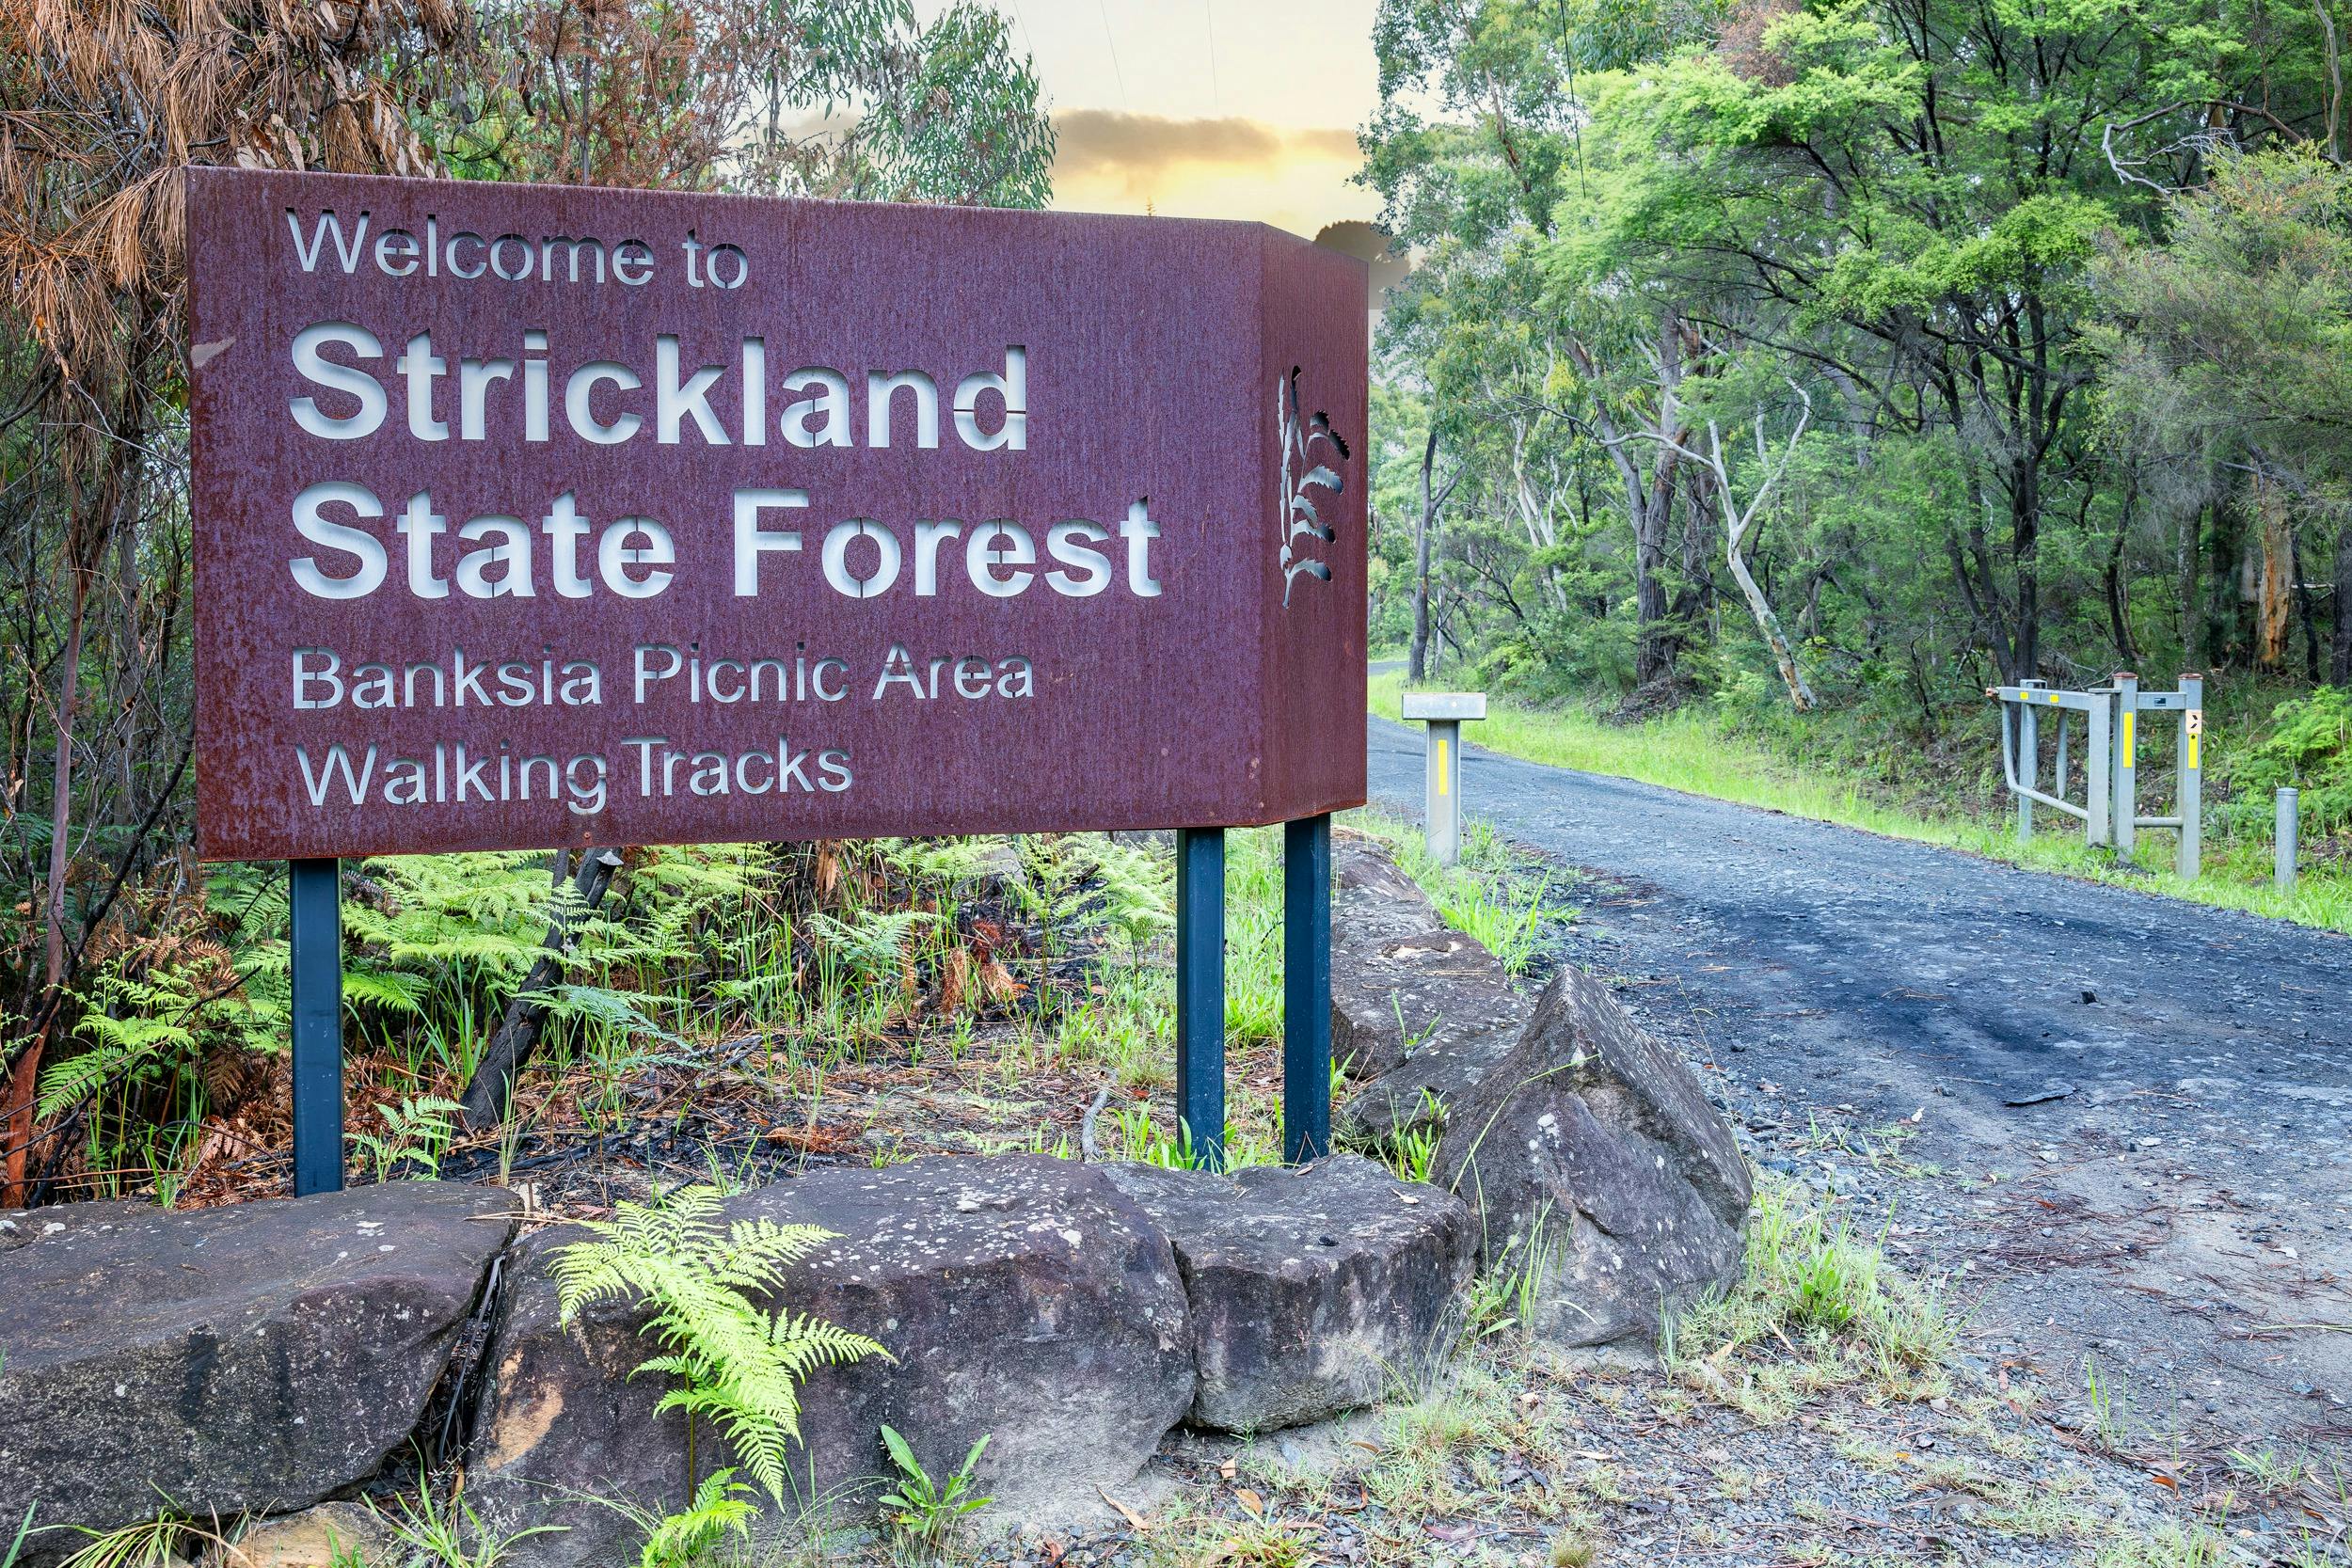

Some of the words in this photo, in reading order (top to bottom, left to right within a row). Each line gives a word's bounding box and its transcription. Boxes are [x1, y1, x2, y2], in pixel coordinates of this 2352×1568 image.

[285, 207, 655, 286] Welcome
[681, 229, 748, 290] to
[289, 321, 1027, 451] Strickland
[288, 482, 676, 600] State
[734, 487, 1163, 599] Forest
[291, 643, 602, 710] Banksia
[633, 641, 850, 705] Picnic
[872, 640, 1034, 699] Area
[295, 741, 608, 815] Walking
[620, 734, 853, 798] Tracks
